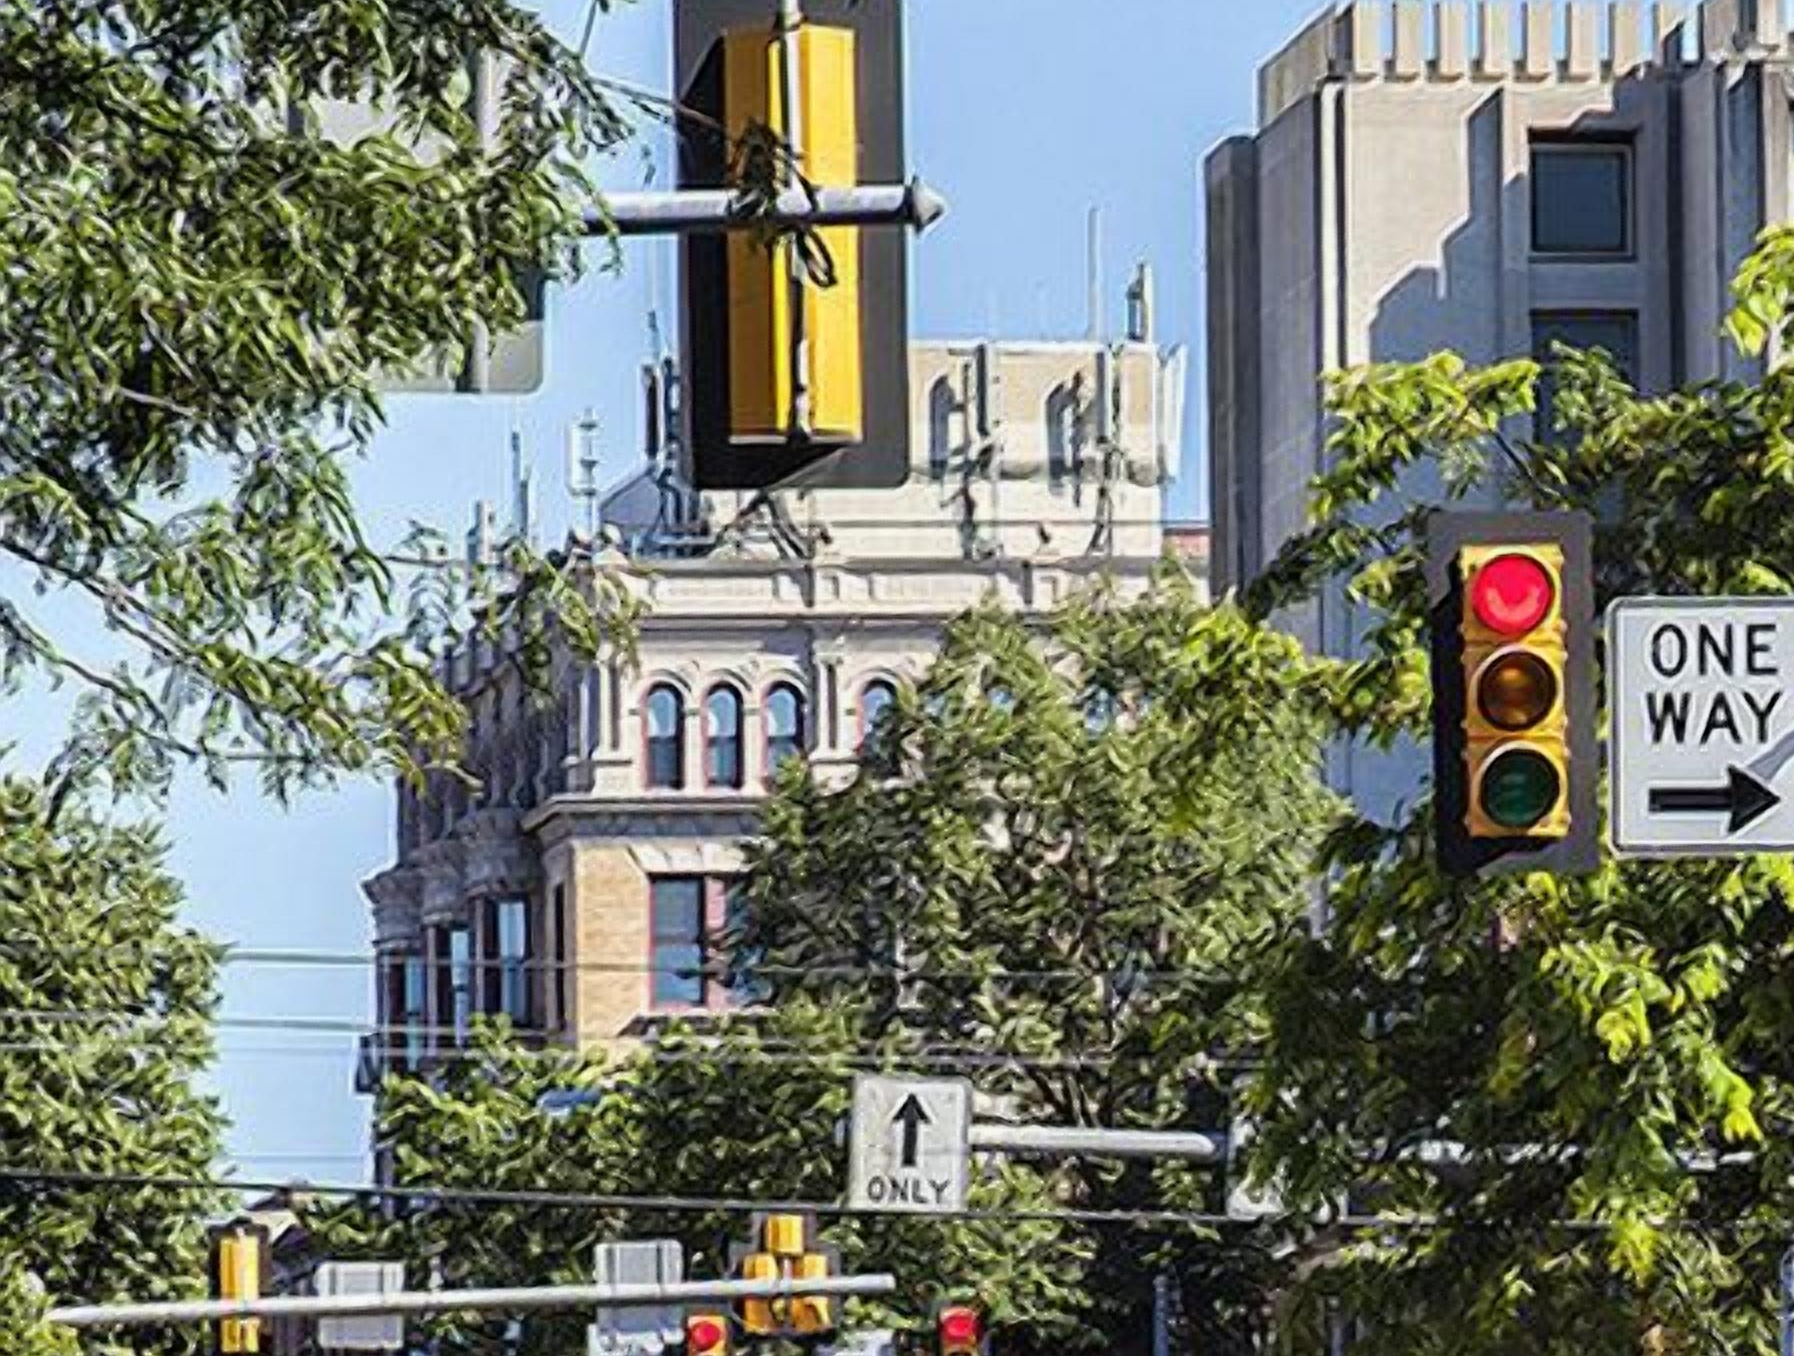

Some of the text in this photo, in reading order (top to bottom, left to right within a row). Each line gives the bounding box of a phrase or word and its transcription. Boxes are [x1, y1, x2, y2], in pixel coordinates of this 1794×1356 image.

[1651, 622, 1778, 678] ONE
[1646, 691, 1784, 746] WAY
[867, 1175, 951, 1204] ONLY
